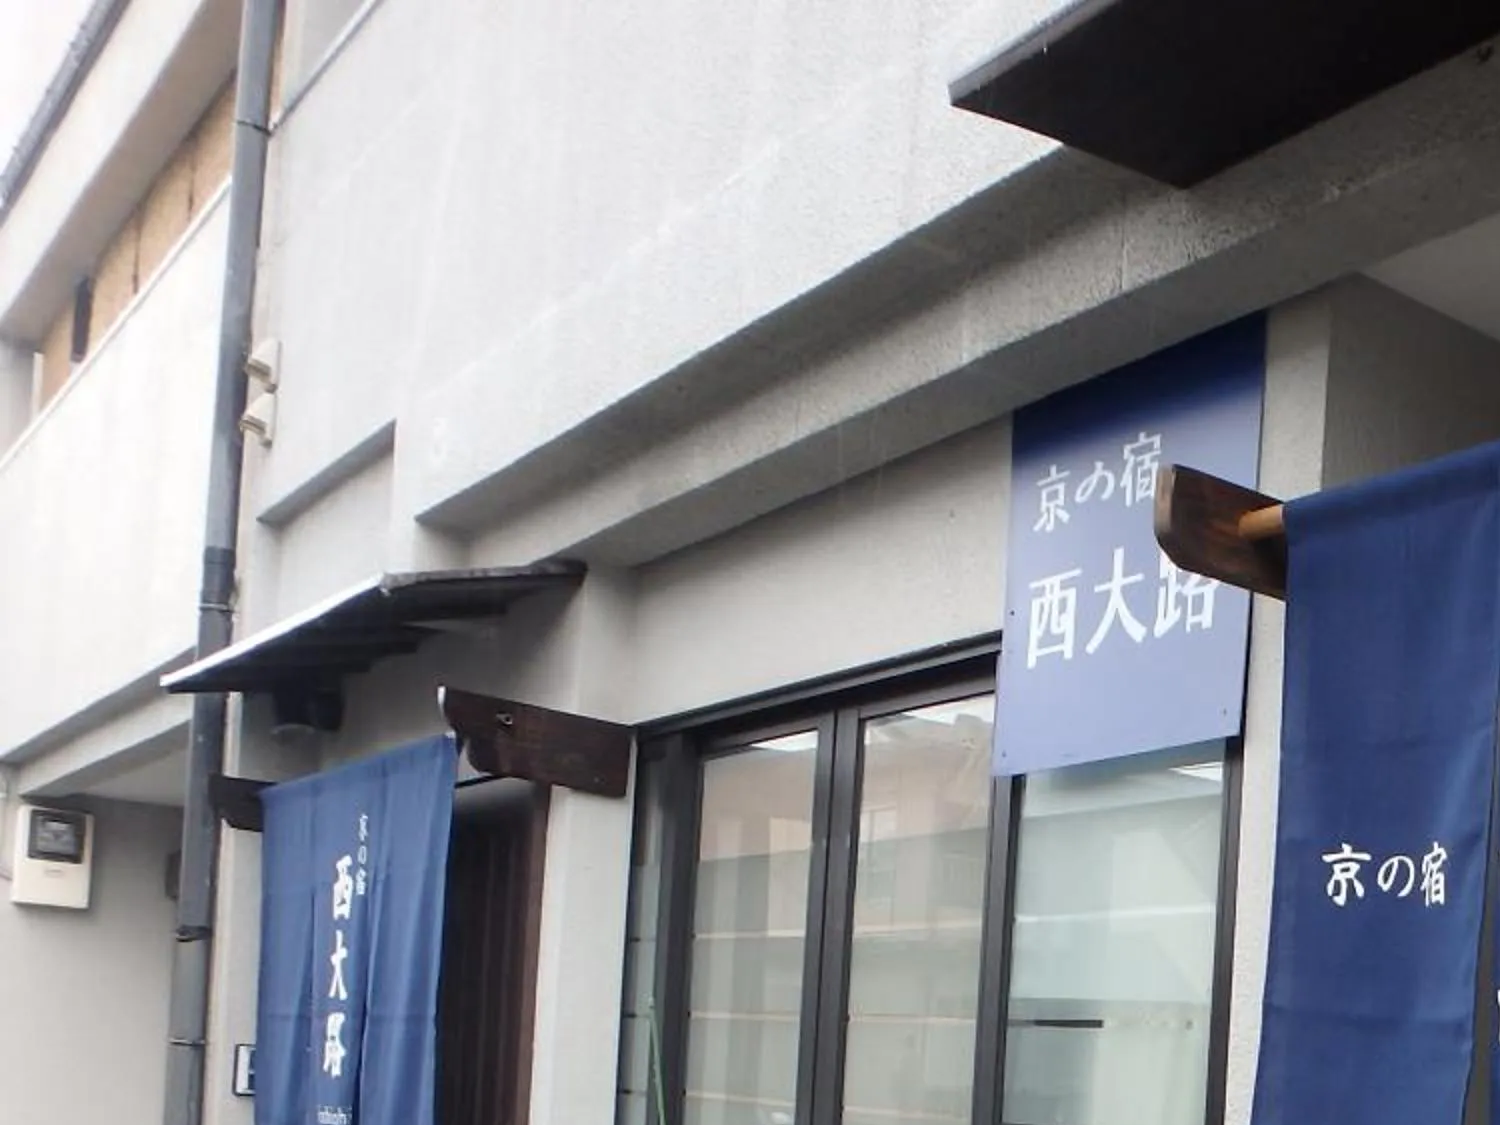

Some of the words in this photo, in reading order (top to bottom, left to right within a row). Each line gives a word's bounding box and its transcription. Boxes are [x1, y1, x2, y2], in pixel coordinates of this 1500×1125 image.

[1033, 431, 1161, 533] 京の宿
[1321, 841, 1448, 908] 京の宿
